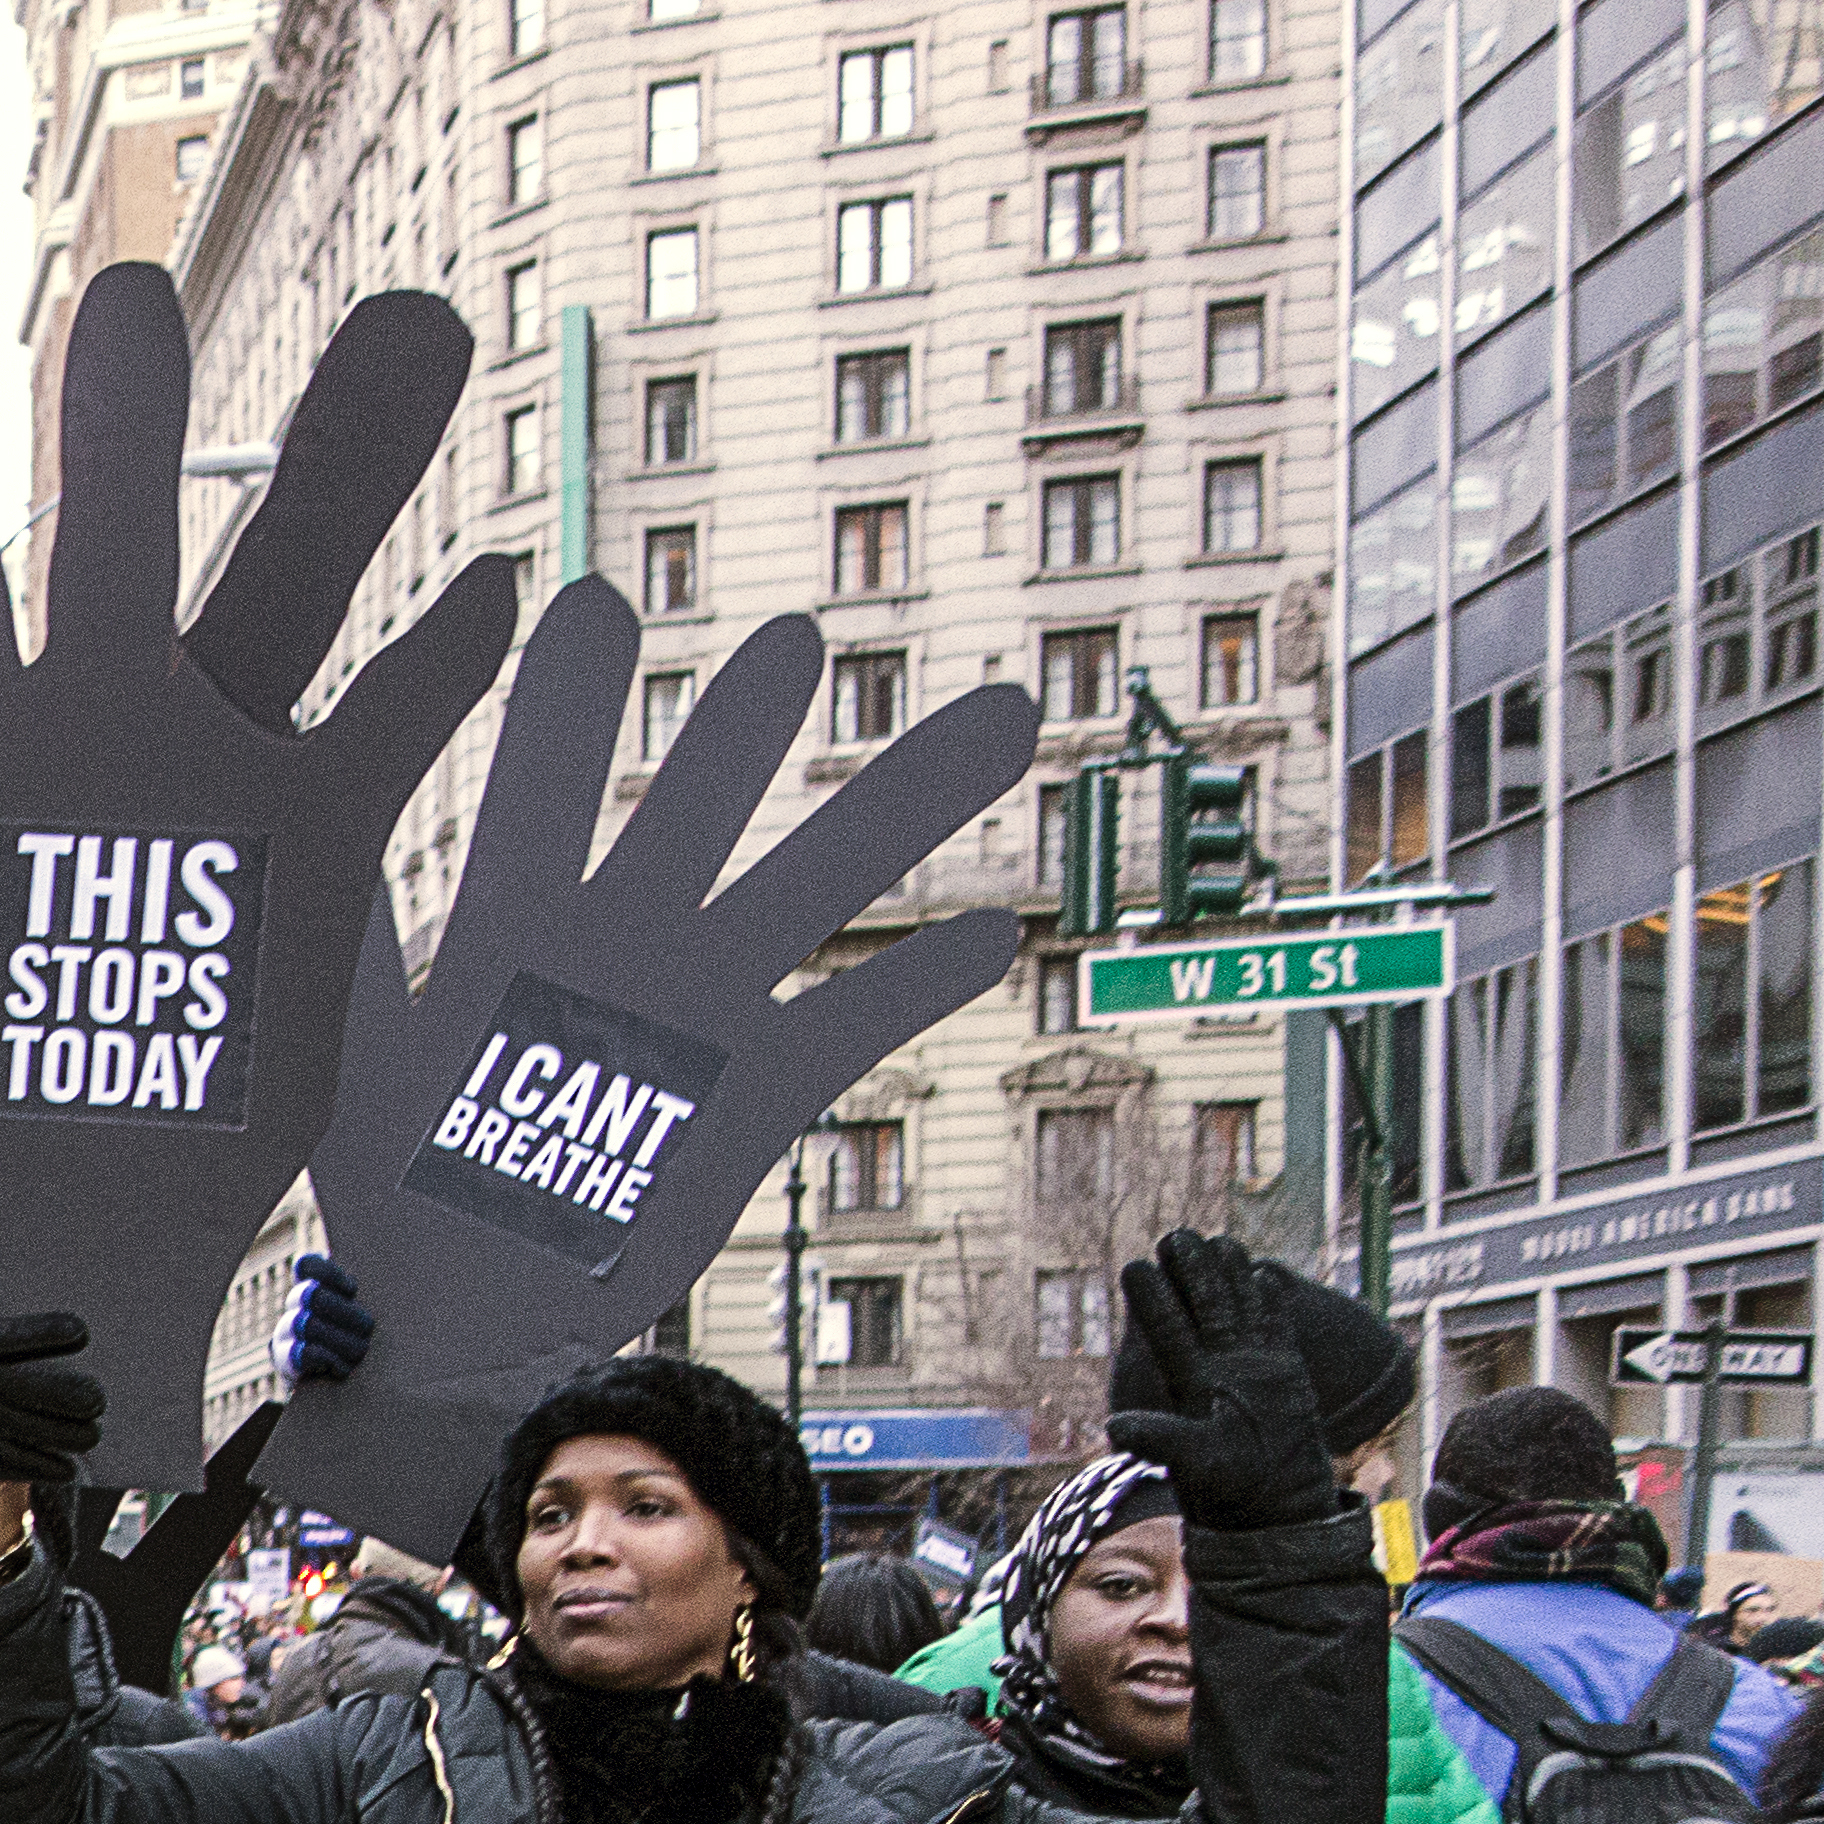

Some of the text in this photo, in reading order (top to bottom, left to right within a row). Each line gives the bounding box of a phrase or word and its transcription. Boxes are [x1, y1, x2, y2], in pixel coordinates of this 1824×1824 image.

[16, 832, 239, 948] THIS
[4, 944, 229, 1031] STOPS
[1170, 941, 1359, 1002] W 31 St
[0, 1022, 223, 1112] TODAY
[463, 1033, 695, 1171] I CANT
[432, 1095, 652, 1225] BREATHE
